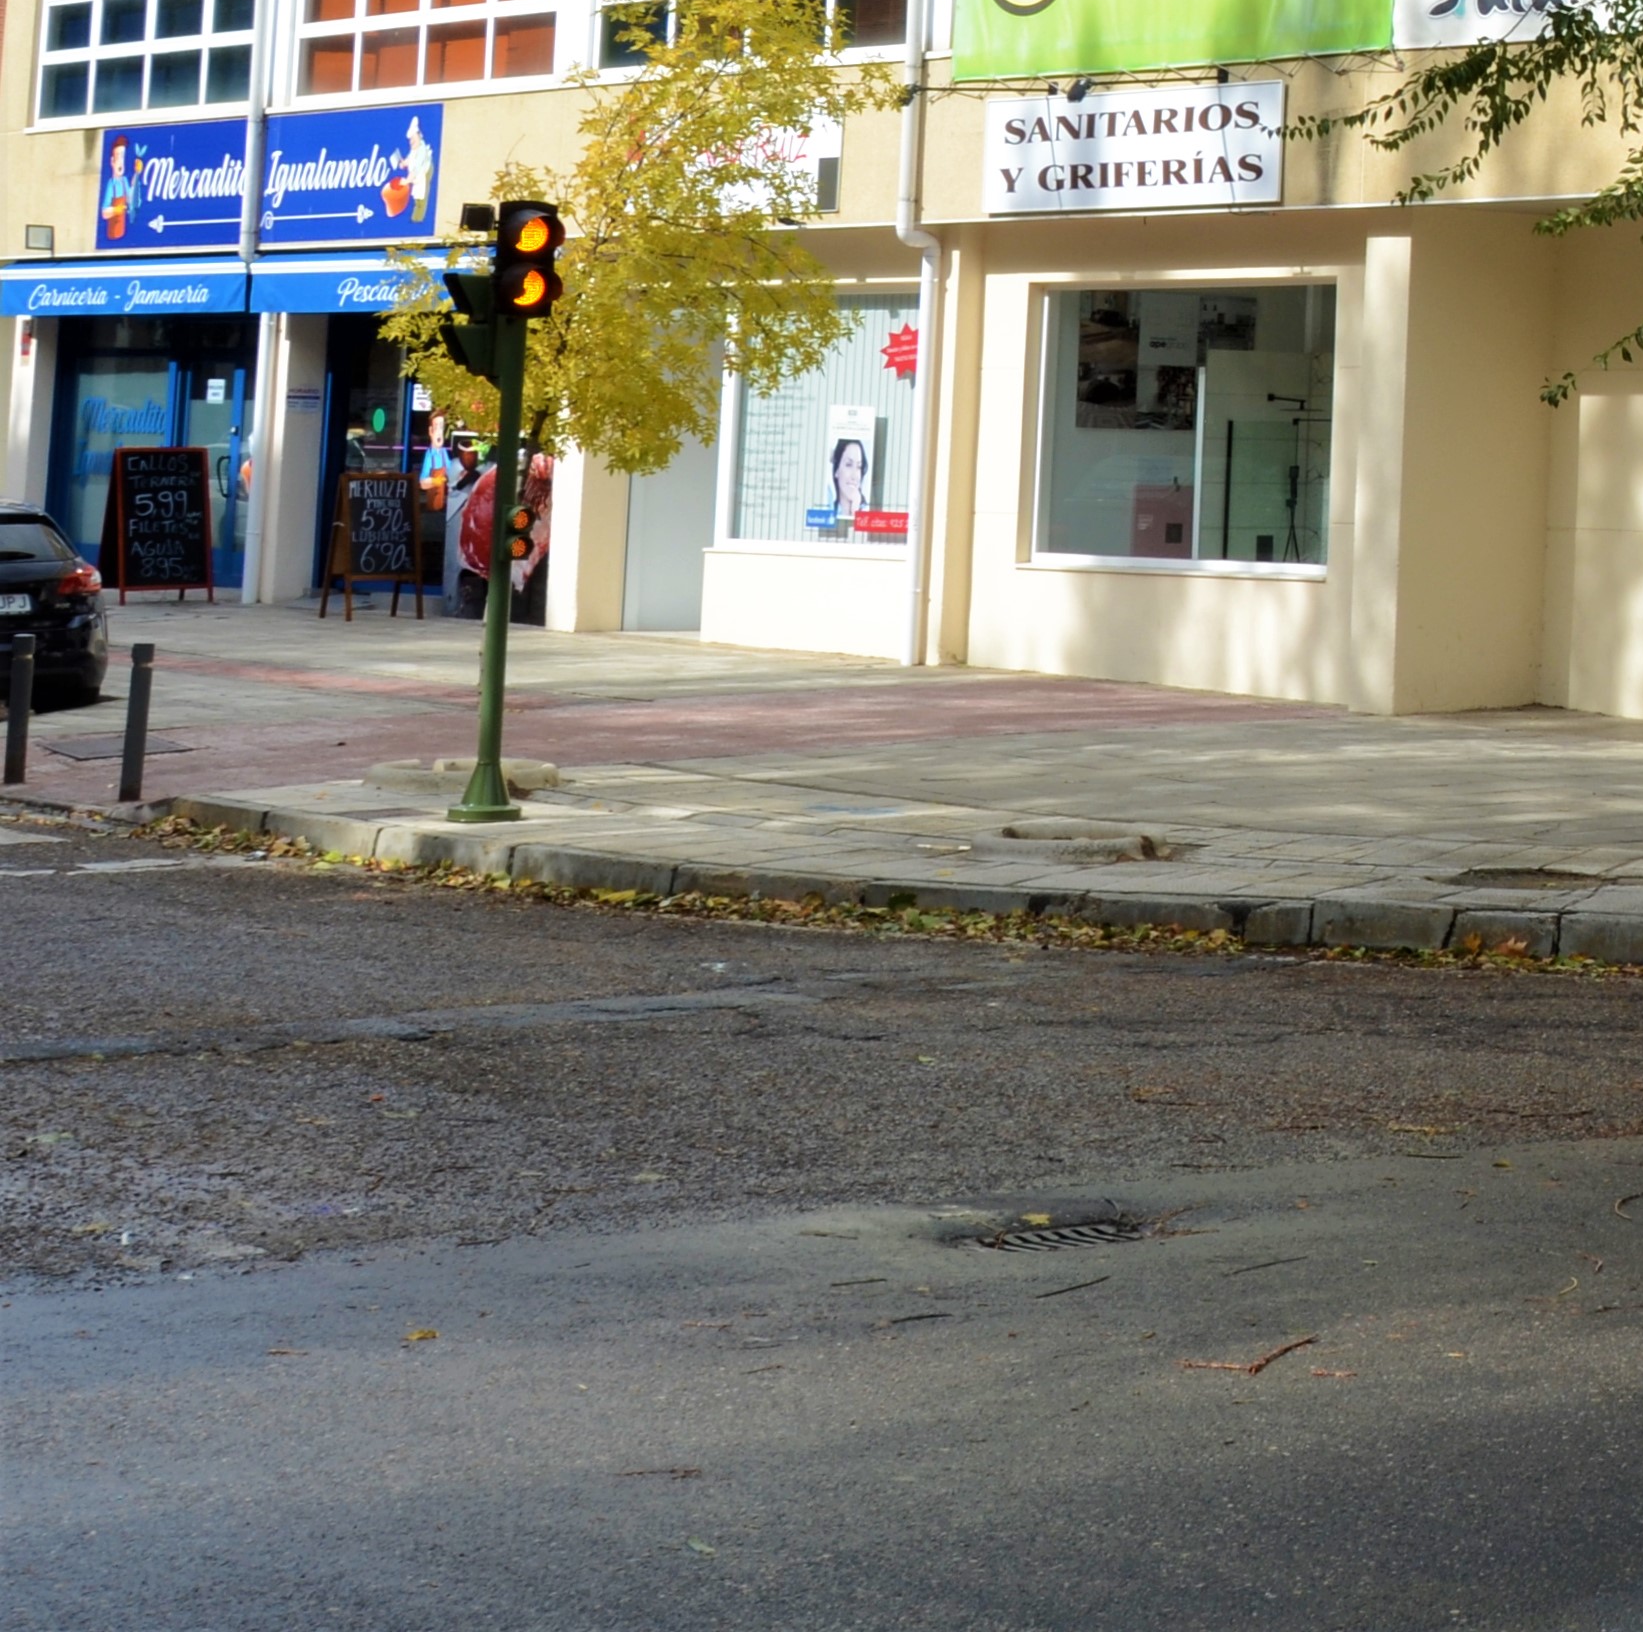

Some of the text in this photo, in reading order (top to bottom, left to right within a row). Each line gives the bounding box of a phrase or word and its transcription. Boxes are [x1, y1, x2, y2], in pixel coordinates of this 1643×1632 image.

[1004, 101, 1260, 145] SANITARIOS
[264, 144, 393, 208] Igualamelo
[1000, 151, 1263, 193] Y GRIFERÍAS
[28, 283, 108, 311] Carnicería
[124, 279, 210, 312] Jamonería
